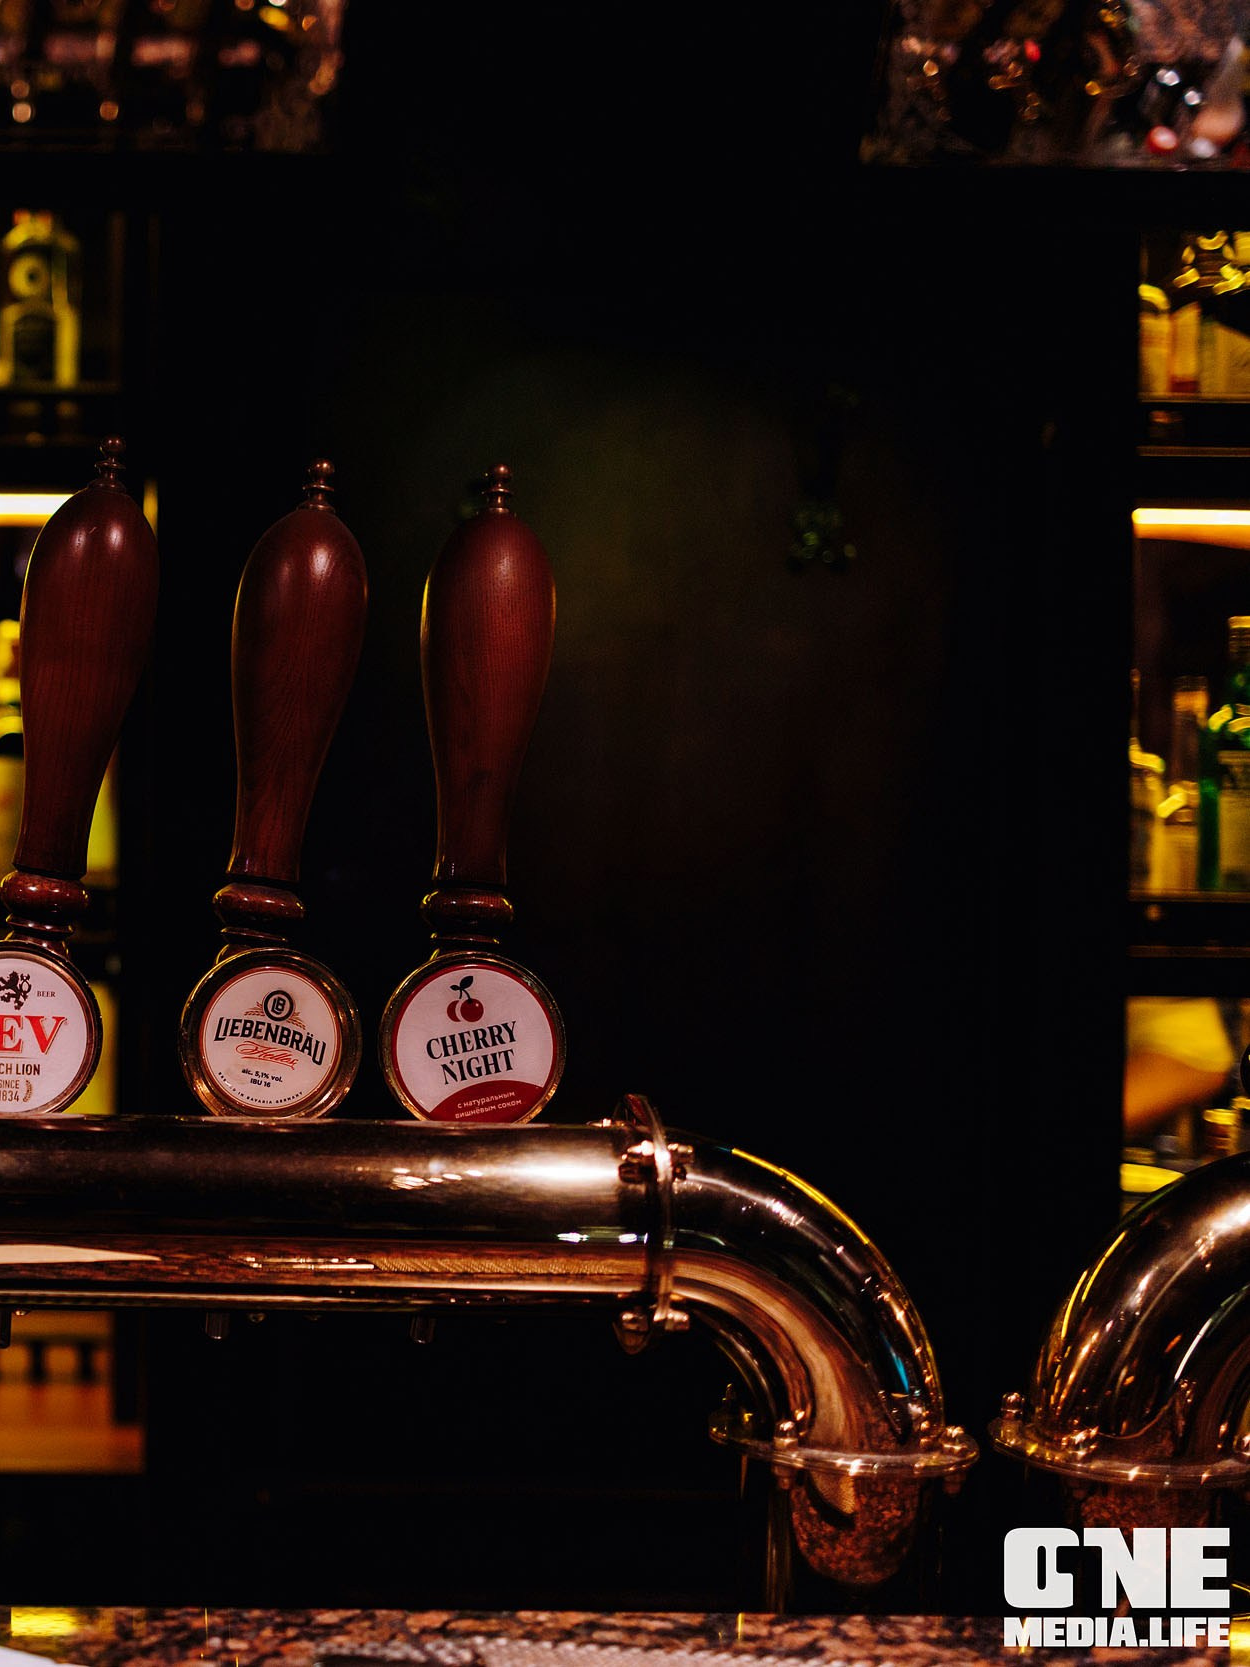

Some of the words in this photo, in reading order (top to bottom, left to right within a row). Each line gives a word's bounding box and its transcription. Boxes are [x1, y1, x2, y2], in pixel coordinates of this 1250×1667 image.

[36, 990, 56, 998] BEER
[214, 1017, 327, 1066] LIEBENBRÄU
[426, 1021, 517, 1060] CHERRY
[236, 1040, 299, 1070] Helles
[15, 1063, 41, 1076] LION
[241, 1068, 253, 1077] alc.
[254, 1070, 270, 1081] 5,1%
[271, 1074, 283, 1083] vol.
[441, 1049, 514, 1085] NIGHT
[218, 1071, 236, 1092] BRED
[246, 1096, 272, 1104] BAVARIA
[275, 1091, 303, 1104] GERMANY
[250, 1078, 263, 1086] IBU
[263, 1080, 271, 1088] 16
[463, 1090, 515, 1108] натуральным
[497, 1099, 522, 1109] соком
